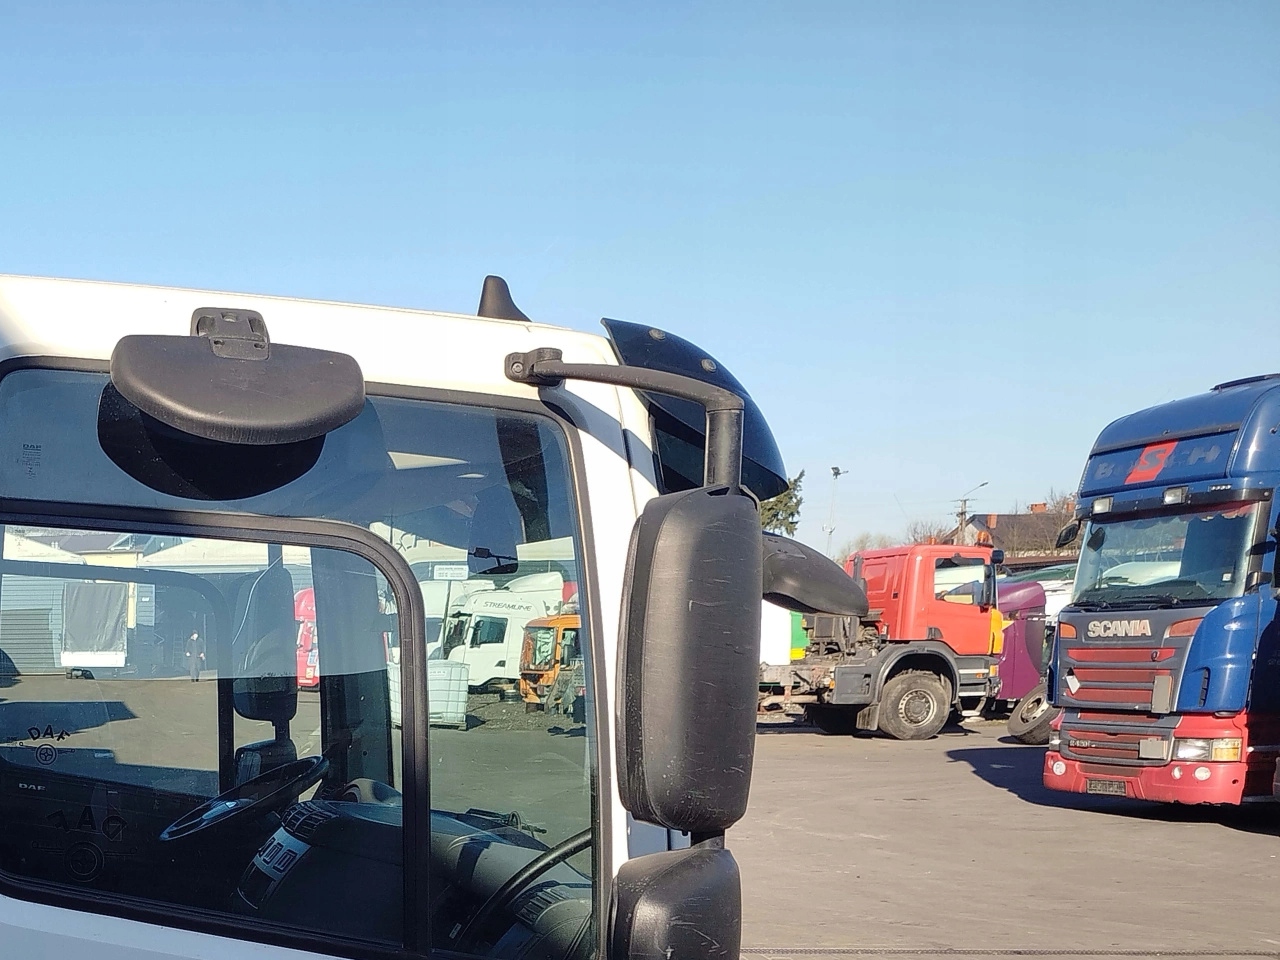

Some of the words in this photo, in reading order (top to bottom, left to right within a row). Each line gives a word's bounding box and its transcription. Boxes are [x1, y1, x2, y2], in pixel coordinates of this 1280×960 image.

[482, 600, 533, 612] STREAMLINE
[1087, 619, 1152, 638] SCANIA
[26, 724, 71, 741] DAF
[18, 782, 47, 792] DAF
